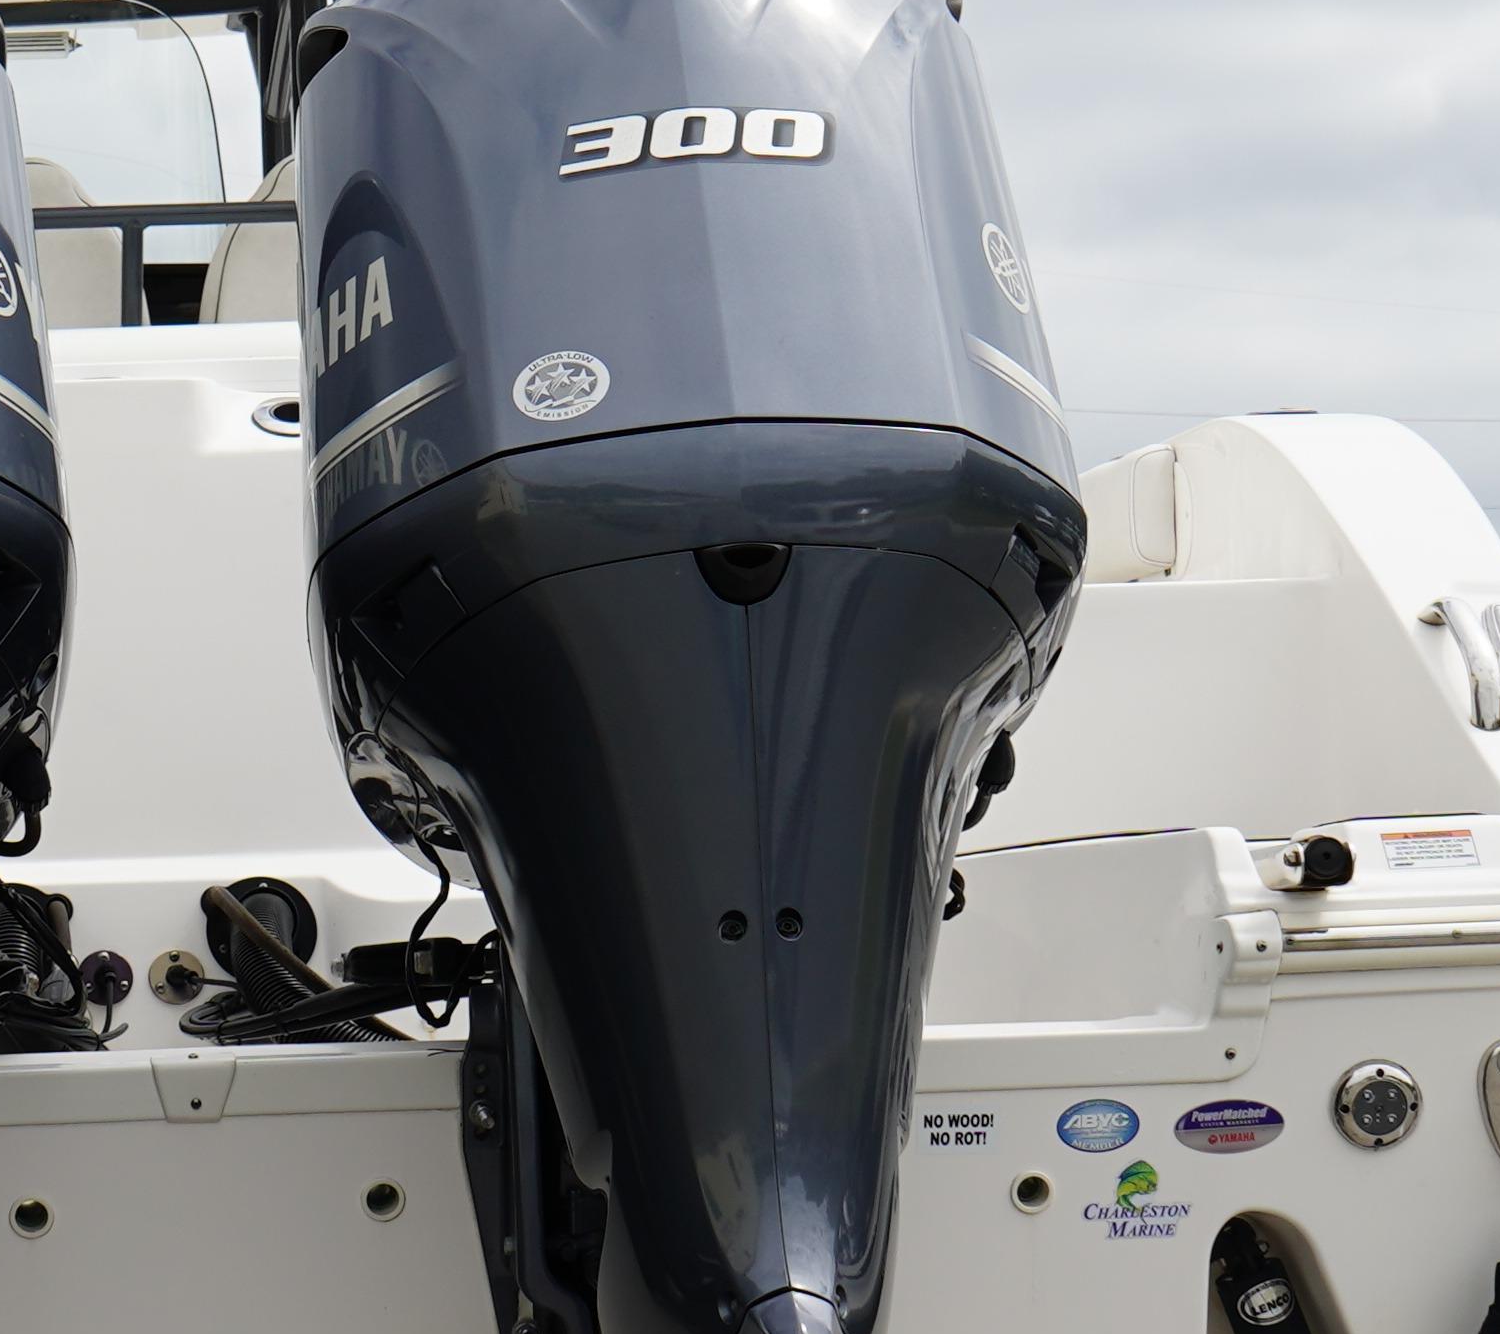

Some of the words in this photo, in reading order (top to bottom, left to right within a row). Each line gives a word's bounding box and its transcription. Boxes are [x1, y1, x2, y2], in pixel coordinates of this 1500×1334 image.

[559, 107, 825, 176] 300
[536, 403, 589, 418] EMISSION
[923, 1114, 944, 1128] NO
[948, 1113, 994, 1128] WOOD!
[1062, 1112, 1130, 1131] ABYC
[1191, 1106, 1268, 1122] PowerMatched
[930, 1132, 950, 1146] NO
[955, 1131, 986, 1145] ROT!
[1219, 1131, 1256, 1143] YAMAHA
[1083, 1203, 1191, 1220] CHARLESTON
[1107, 1220, 1176, 1239] MARINE
[1251, 1293, 1290, 1317] LENCO
